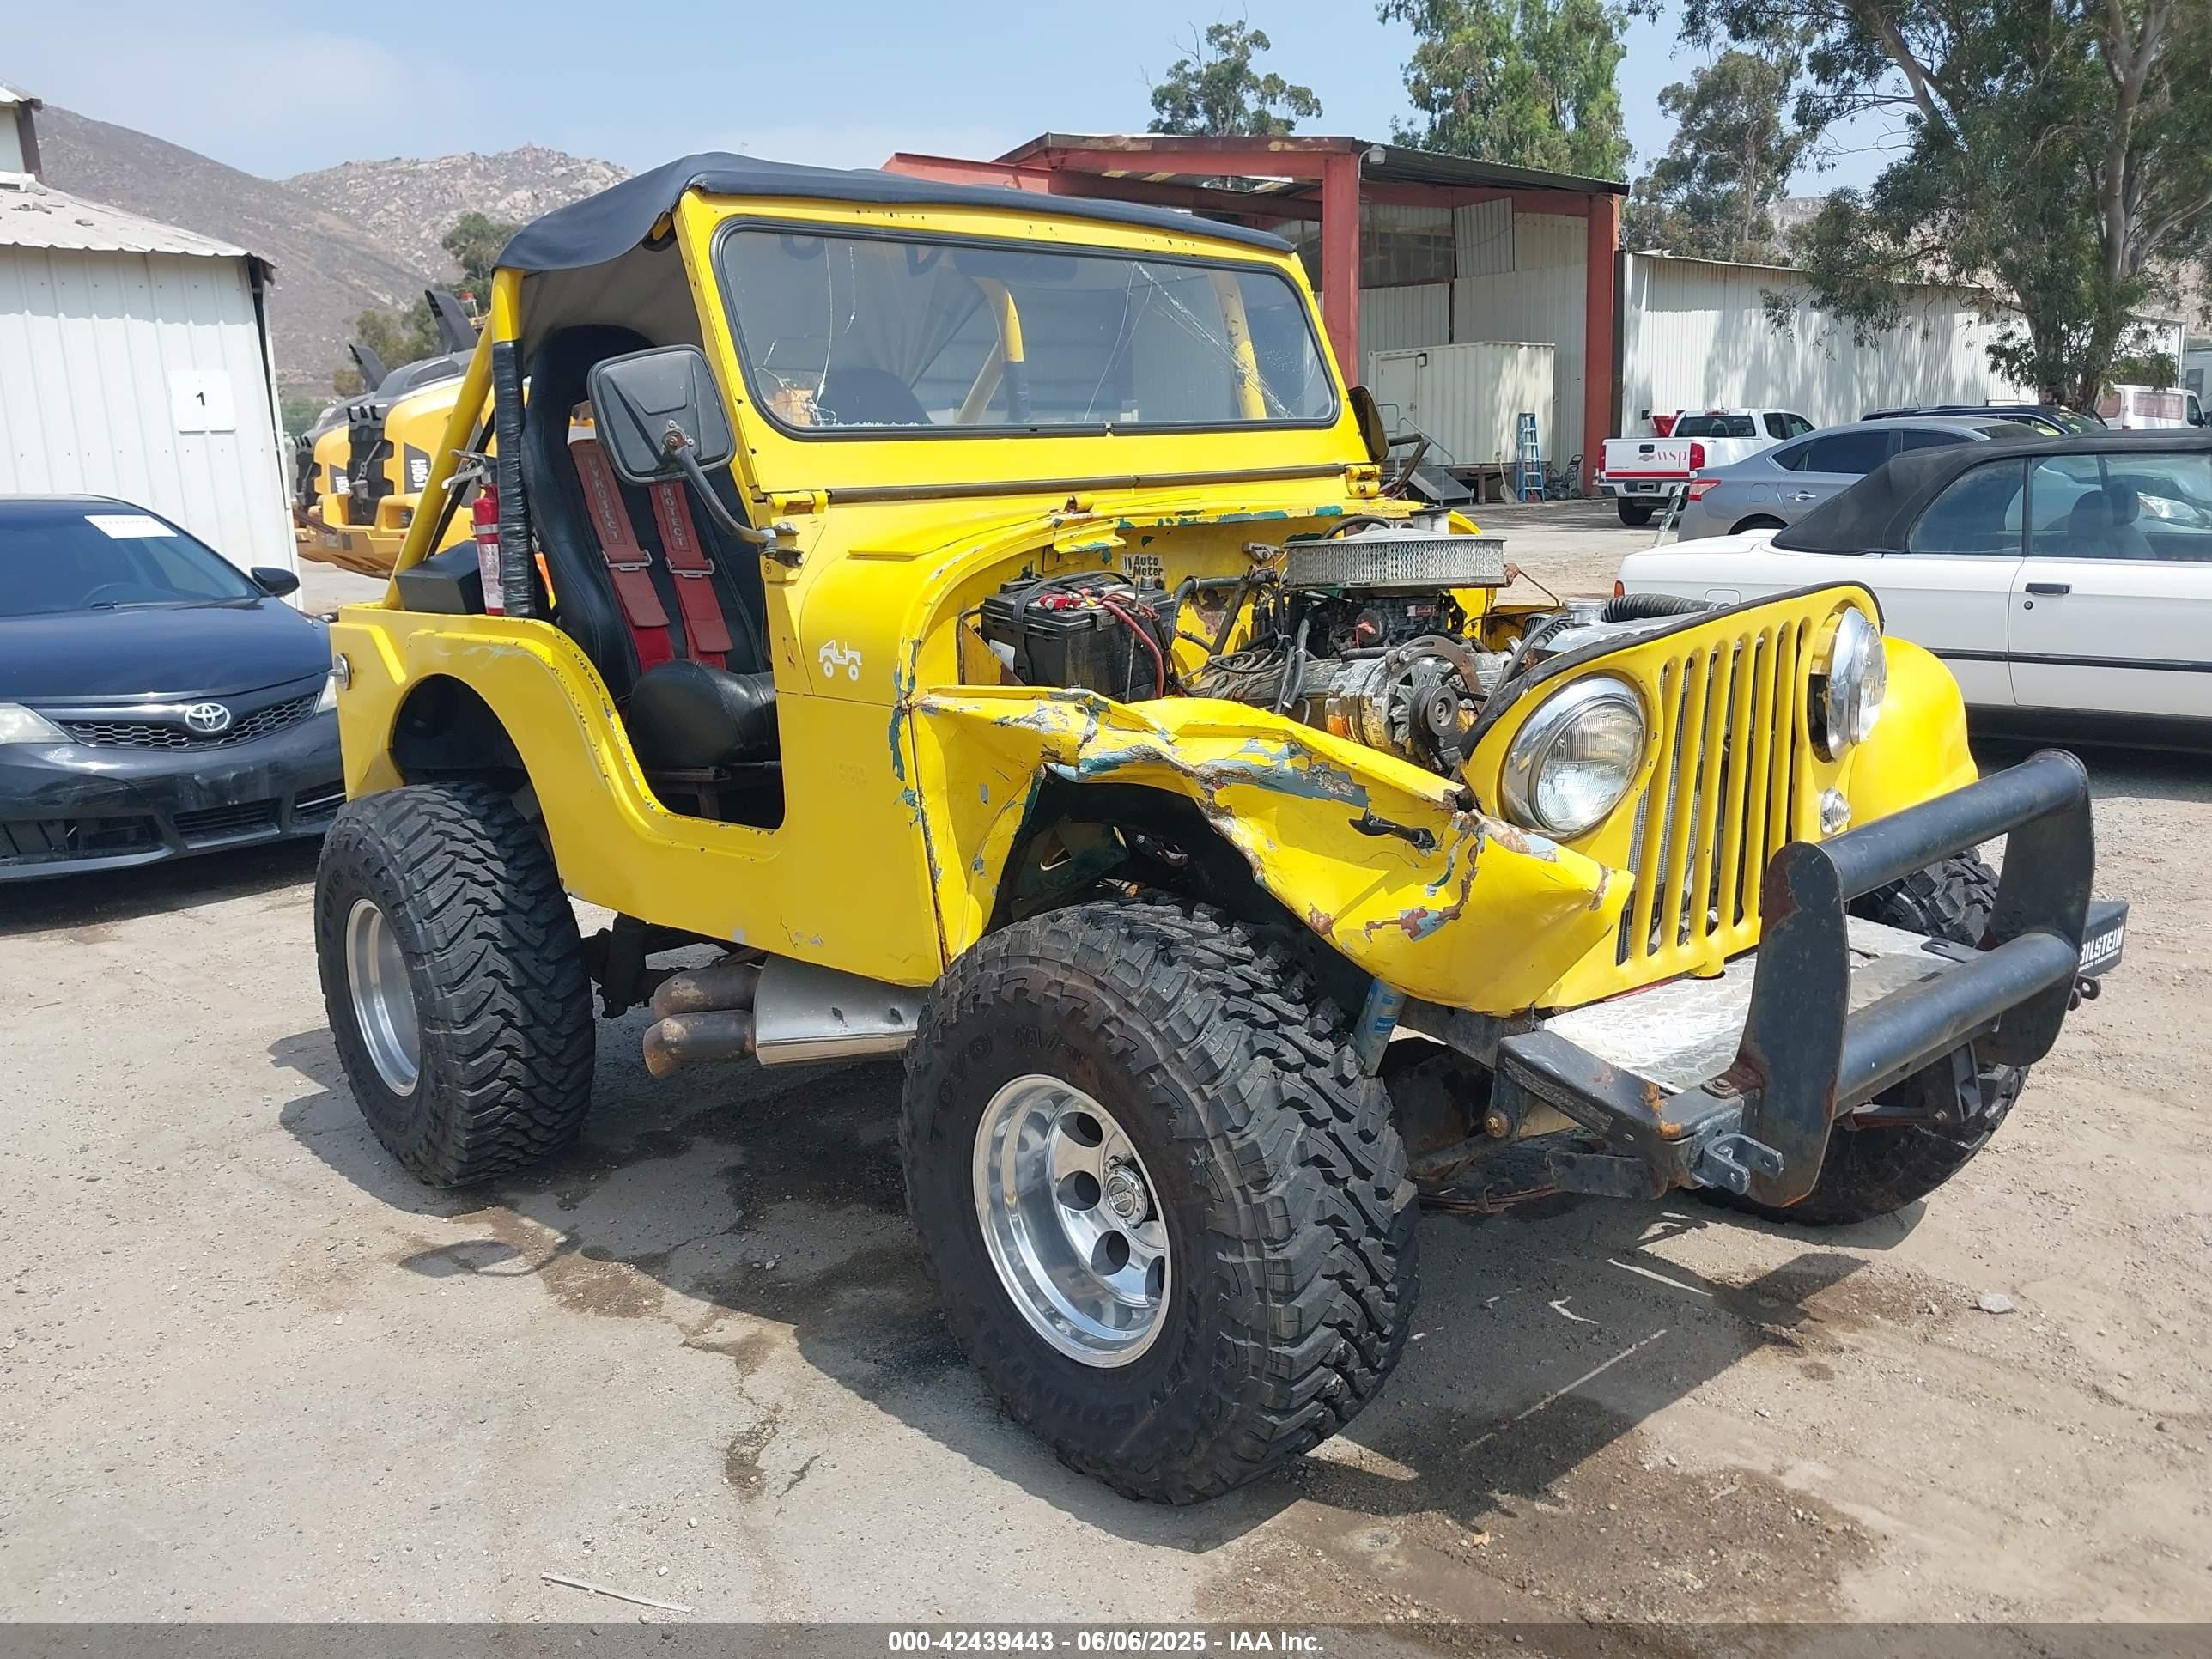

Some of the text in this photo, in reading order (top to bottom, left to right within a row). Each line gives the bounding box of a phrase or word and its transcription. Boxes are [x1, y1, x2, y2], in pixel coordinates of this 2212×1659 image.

[195, 391, 206, 406] 1
[1656, 450, 1687, 468] wsp
[662, 483, 685, 547] ROTECT
[1133, 556, 1158, 566] Auto
[1133, 566, 1164, 578] Meter
